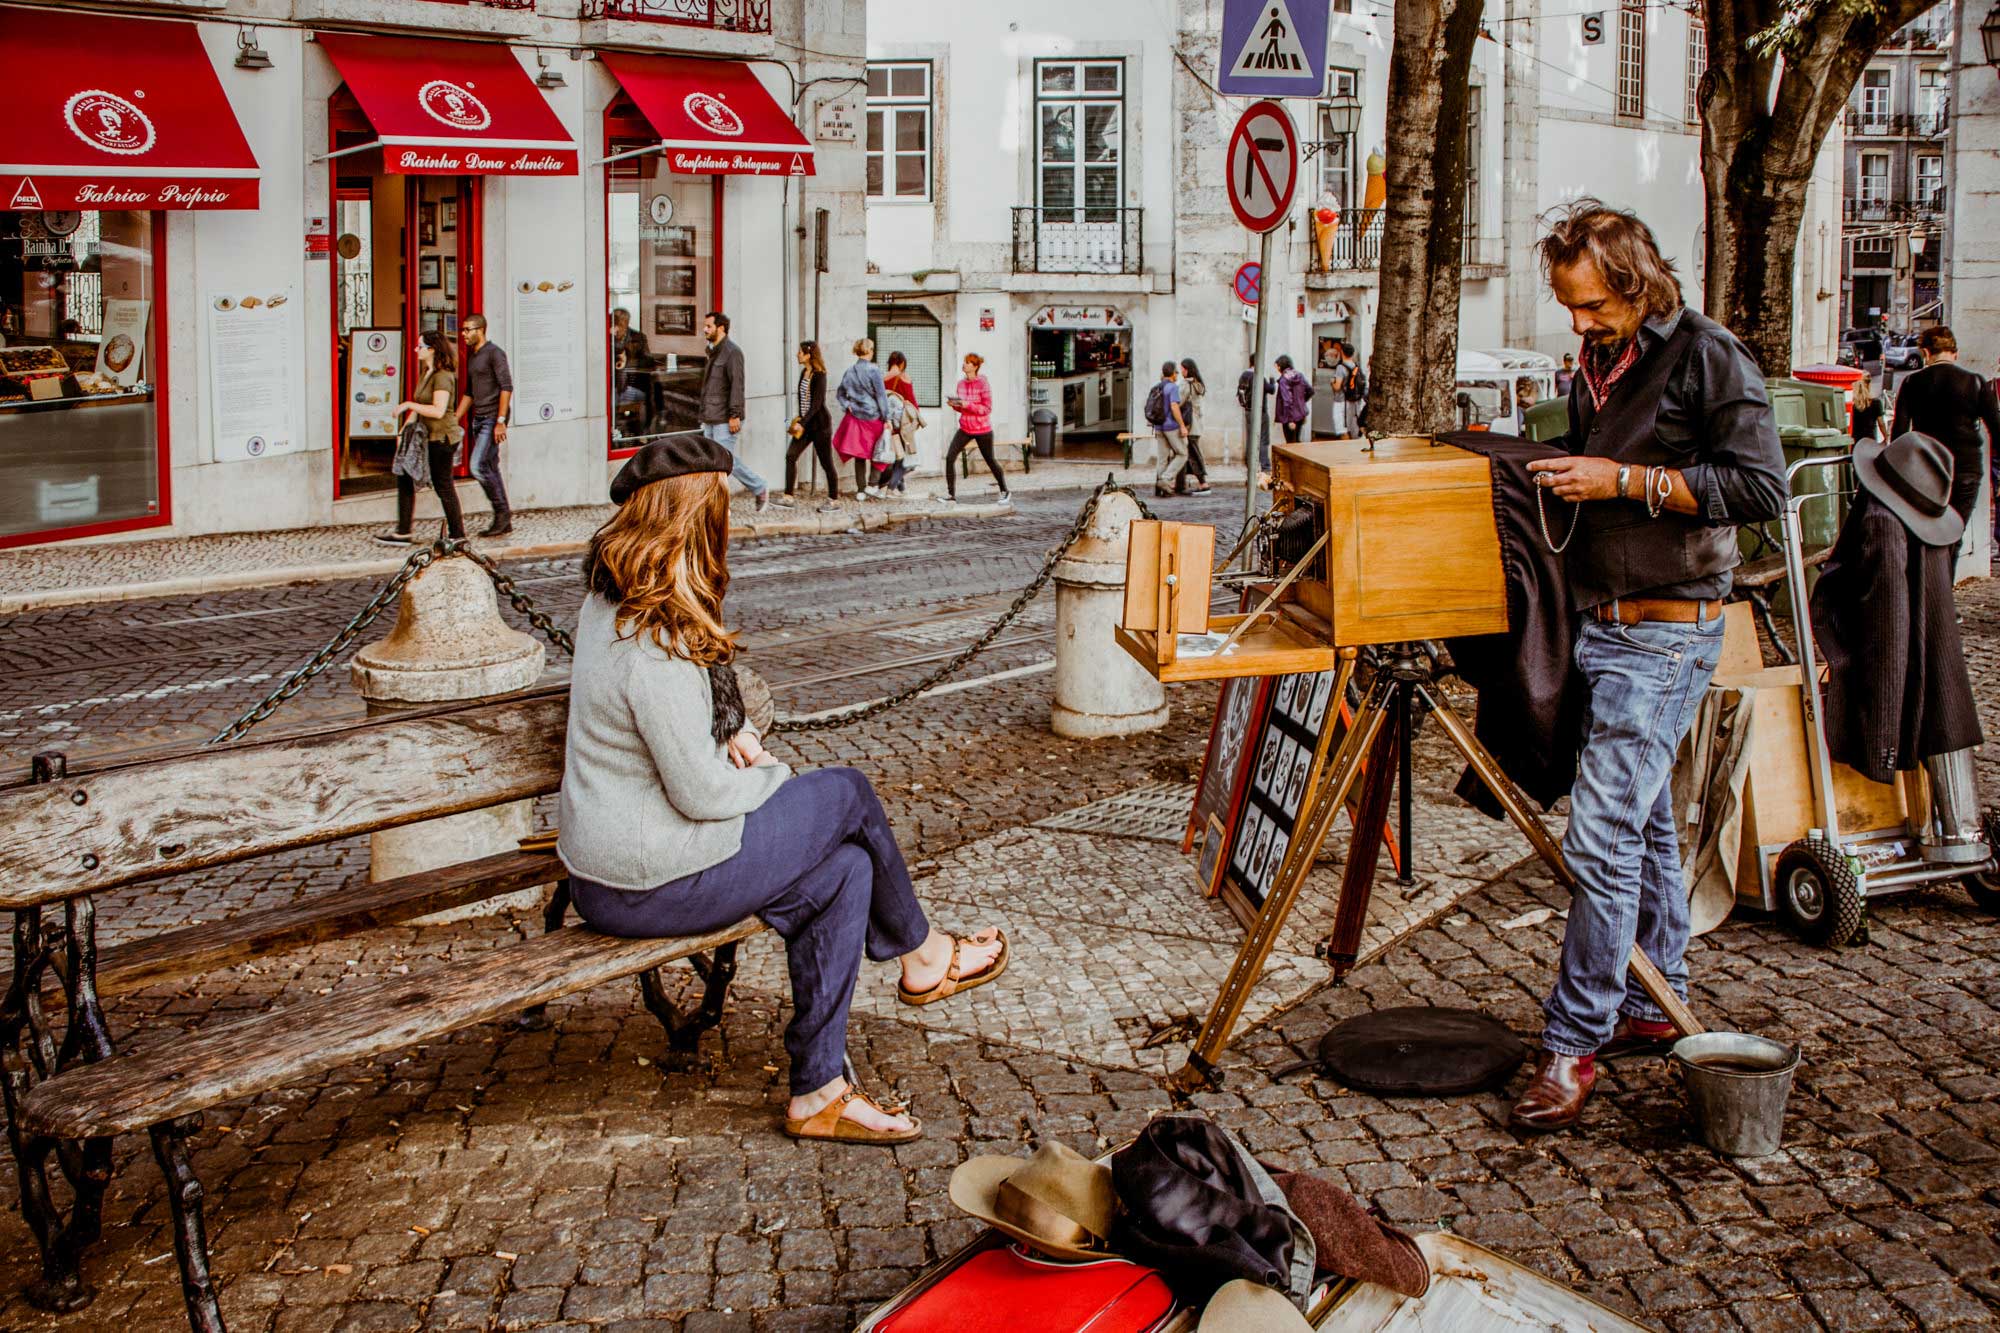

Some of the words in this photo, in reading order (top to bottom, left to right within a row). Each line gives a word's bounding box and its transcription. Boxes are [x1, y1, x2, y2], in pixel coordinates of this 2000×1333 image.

[1584, 17, 1601, 42] S
[400, 151, 460, 169] Rainha
[465, 153, 506, 170] Dona
[510, 154, 564, 171] Amélia
[675, 153, 729, 174] Confeitaria
[732, 154, 781, 175] Portuguesa
[16, 195, 38, 203] DELTA
[75, 184, 150, 203] Fabrico
[158, 184, 229, 209] Próprio
[24, 239, 57, 255] Rainha
